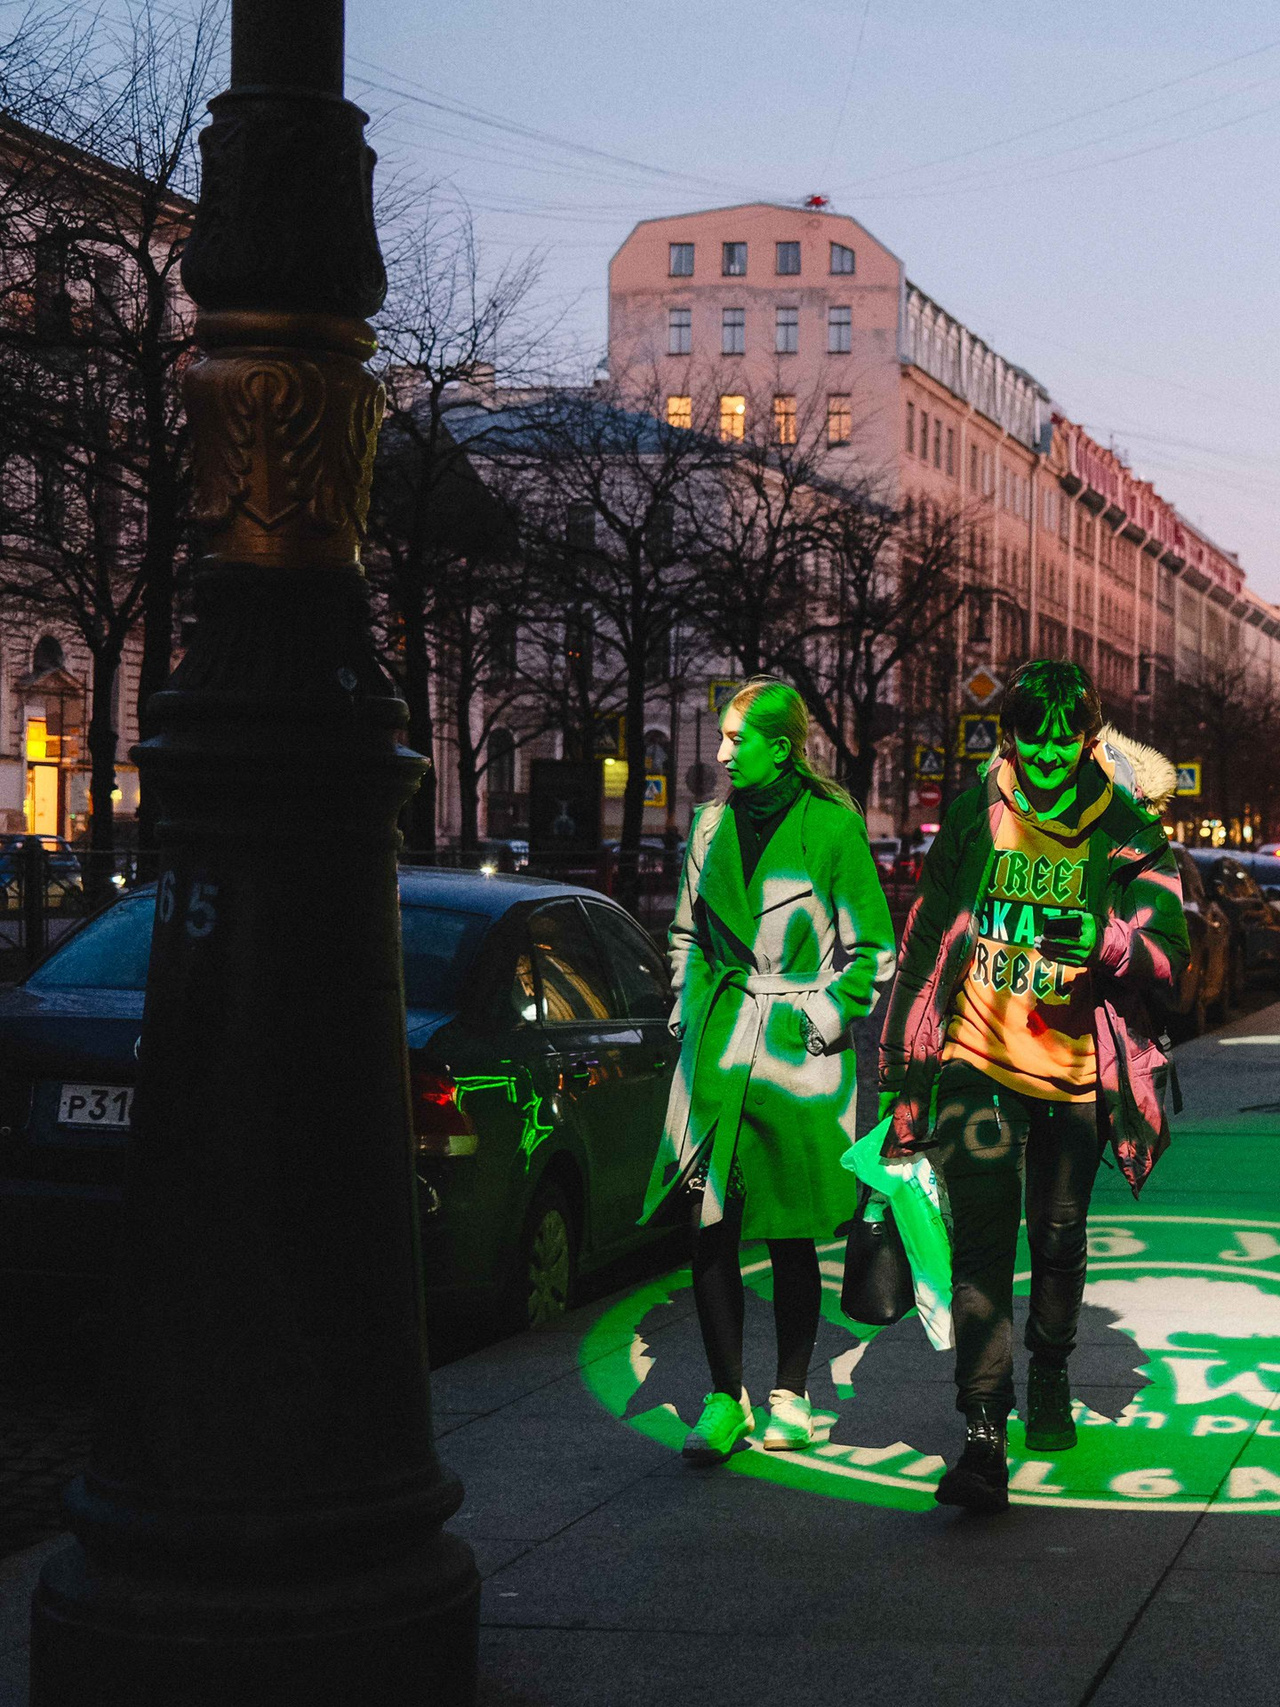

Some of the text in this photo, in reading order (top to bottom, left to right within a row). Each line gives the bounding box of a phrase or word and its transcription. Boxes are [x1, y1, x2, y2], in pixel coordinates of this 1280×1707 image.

[987, 850, 1090, 905] TREET
[972, 942, 1074, 1000] REBEL
[1110, 1468, 1183, 1499] 6
